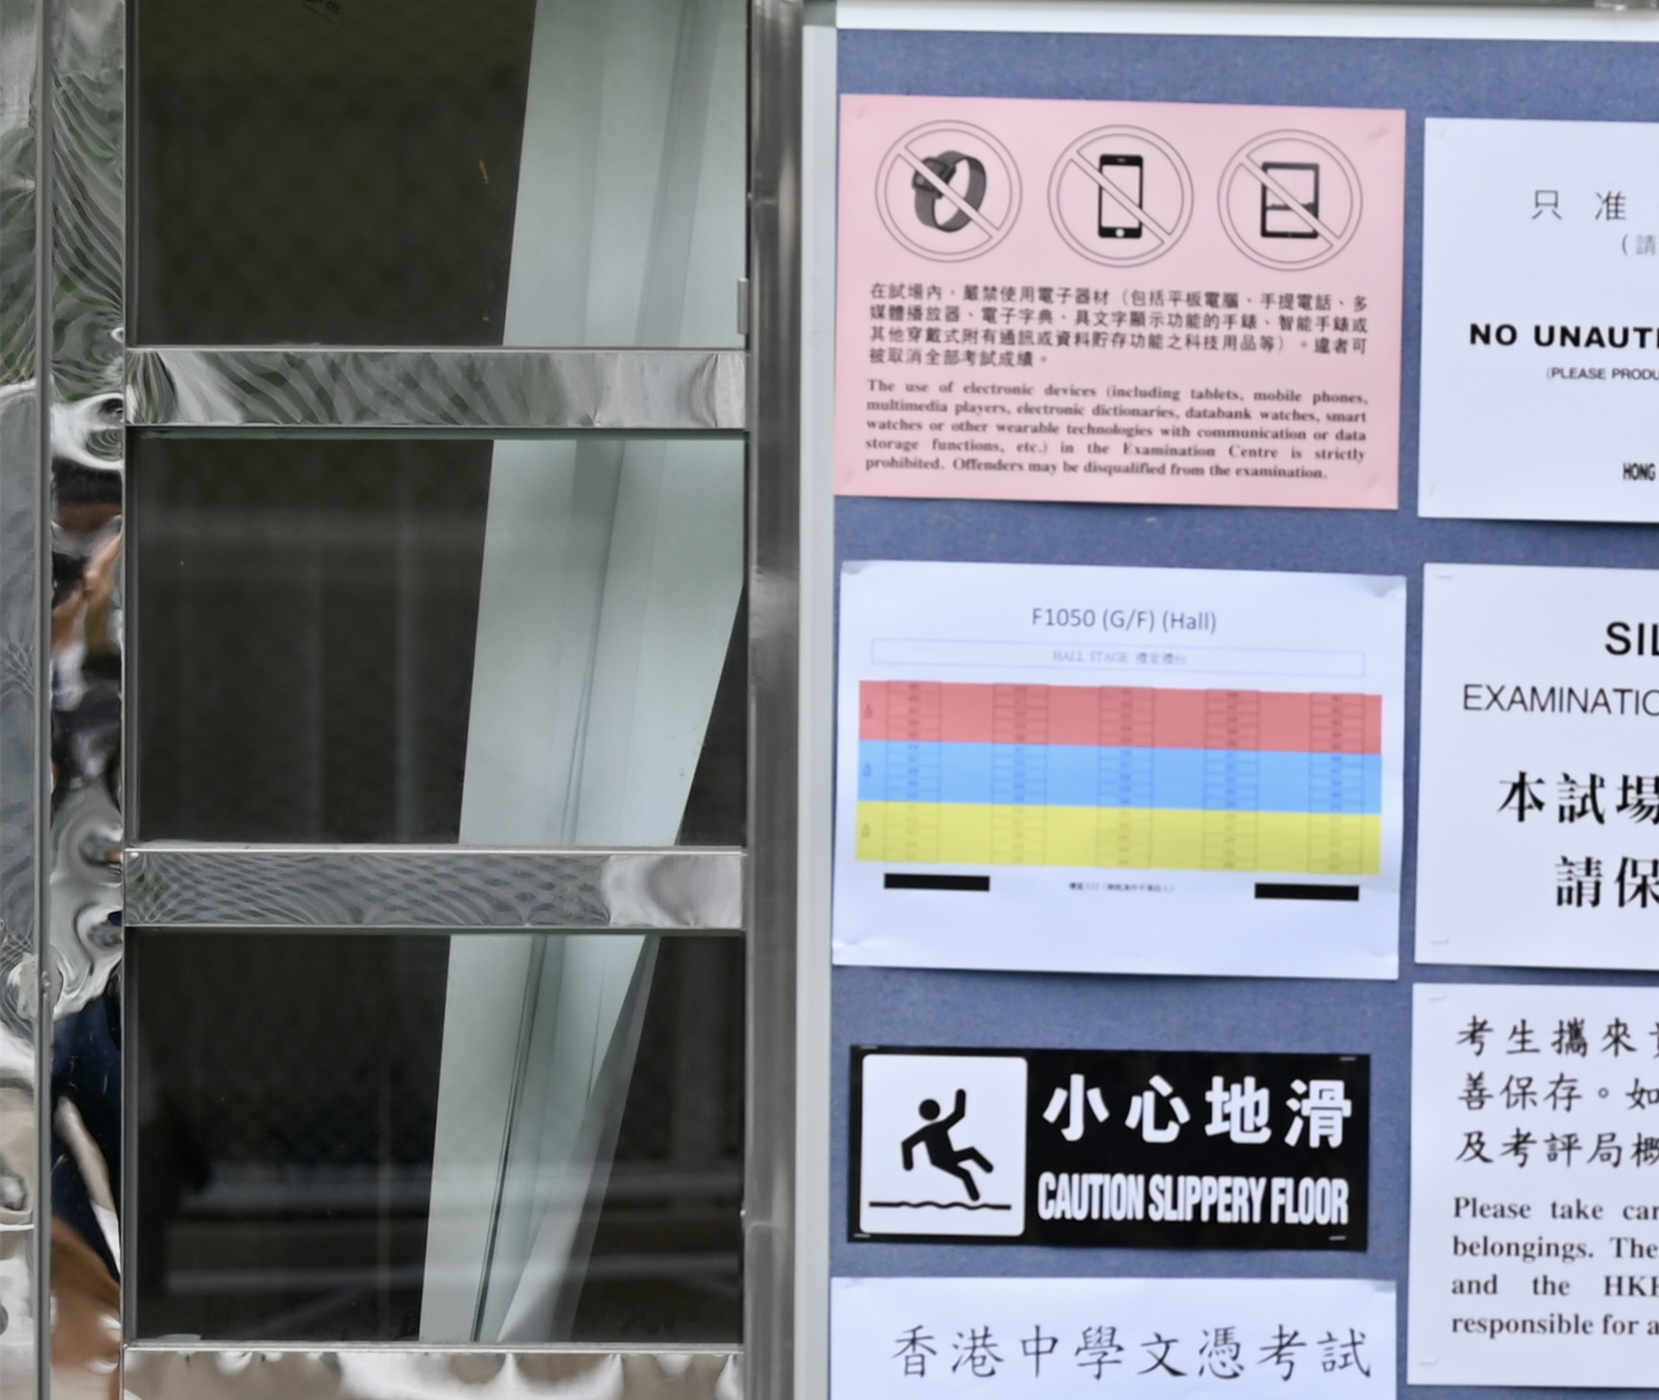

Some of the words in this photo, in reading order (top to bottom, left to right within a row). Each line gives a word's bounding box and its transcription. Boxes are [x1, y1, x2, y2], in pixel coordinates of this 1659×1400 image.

[1469, 323, 1517, 346] NO
[1546, 367, 1605, 379] (PLEASE
[867, 378, 895, 392] The
[905, 383, 928, 392] use
[938, 380, 954, 393] of
[962, 382, 1033, 395] electronic
[1043, 384, 1096, 396] devices
[1106, 385, 1180, 401] (including
[1190, 387, 1244, 400] tablets,
[1253, 389, 1302, 402] mobile
[1312, 391, 1368, 405] phones,
[866, 399, 948, 412] multimedia
[954, 401, 1011, 416] players,
[1016, 402, 1084, 415] electronic
[1091, 404, 1180, 418] dictionaries,
[1184, 406, 1252, 419] databank
[1259, 409, 1320, 422] watches,
[1325, 412, 1366, 422] smart
[866, 418, 923, 430] watches
[928, 422, 944, 431] or
[951, 420, 988, 432] other
[995, 422, 1059, 434] wearable
[1066, 423, 1153, 438] technologies
[1159, 425, 1191, 437] with
[1196, 428, 1307, 439] communication
[1312, 431, 1329, 440] or
[1334, 428, 1366, 441] data
[865, 438, 918, 452] storage
[931, 438, 1004, 452] functions,
[1015, 441, 1048, 453] etc.)
[1060, 441, 1074, 453] in
[1087, 441, 1109, 454] the
[1122, 442, 1216, 456] Examination
[1228, 445, 1278, 458] Centre
[1290, 447, 1302, 459] is
[1314, 448, 1364, 462] strictly
[865, 456, 944, 470] prohibited.
[952, 458, 1024, 471] Offenders
[1027, 462, 1057, 475] may
[1062, 460, 1079, 472] be
[1083, 461, 1166, 476] disqualified
[1169, 463, 1205, 476] from
[1209, 464, 1231, 476] the
[1234, 466, 1326, 478] examination.
[1622, 462, 1655, 480] HONG
[1031, 607, 1096, 627] F1050
[1102, 608, 1155, 632] (G/F)
[1162, 610, 1216, 633] (Hall)
[1042, 1075, 1352, 1146] 小心地滑
[1037, 1173, 1144, 1219] CAUTION
[1148, 1175, 1266, 1221] SLIPPERY
[1270, 1177, 1348, 1223] FLOOR
[1454, 1197, 1531, 1218] Please
[1551, 1198, 1603, 1219] take
[1453, 1235, 1593, 1261] belongings.
[1610, 1237, 1658, 1258] The
[1451, 1274, 1497, 1294] and
[1532, 1274, 1570, 1295] the
[1452, 1313, 1593, 1338] responsible
[1602, 1313, 1639, 1334] for
[894, 1325, 1371, 1379] 香港中學文憑考試
